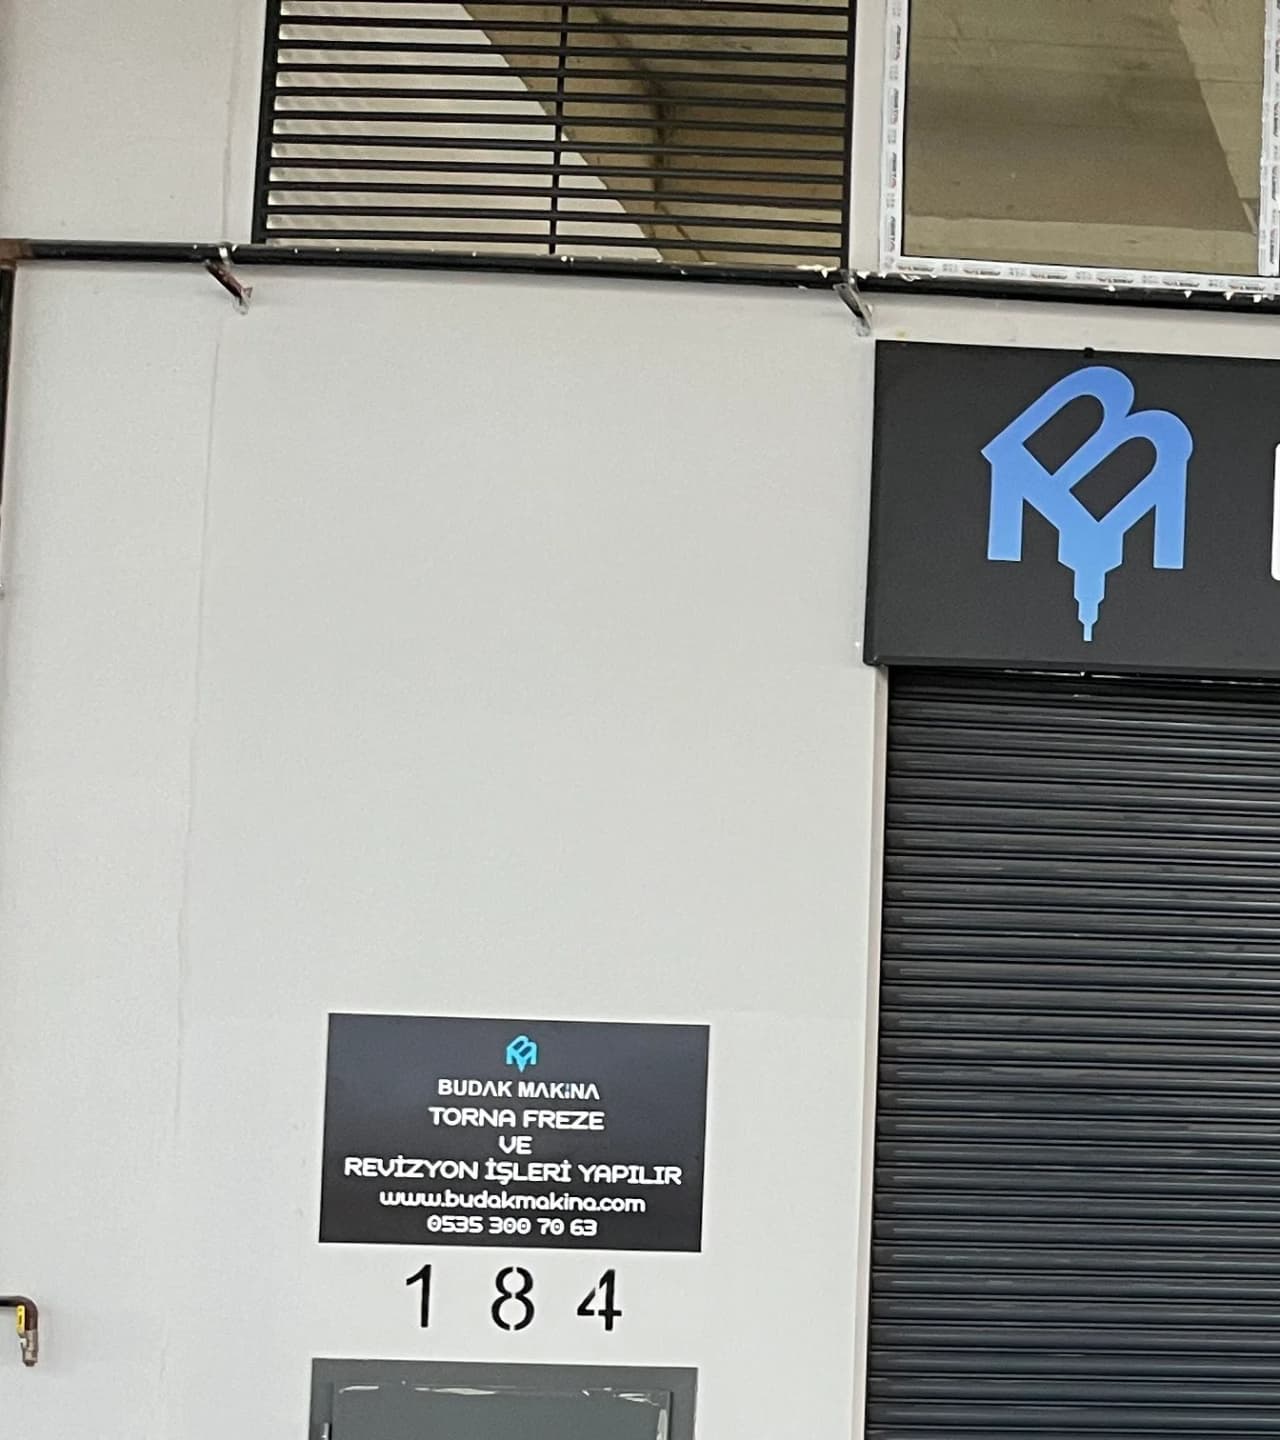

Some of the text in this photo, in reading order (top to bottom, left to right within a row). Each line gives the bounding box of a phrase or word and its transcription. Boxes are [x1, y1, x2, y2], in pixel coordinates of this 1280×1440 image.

[438, 1079, 513, 1098] BUDAK
[428, 1106, 605, 1131] TORNA FREZE
[499, 1135, 533, 1155] VE
[344, 1154, 682, 1186] REVİZYON İŞLERİ YAPILIR
[379, 1188, 646, 1213] www.budakmakina.com
[426, 1214, 598, 1237] 0535 300 70 63
